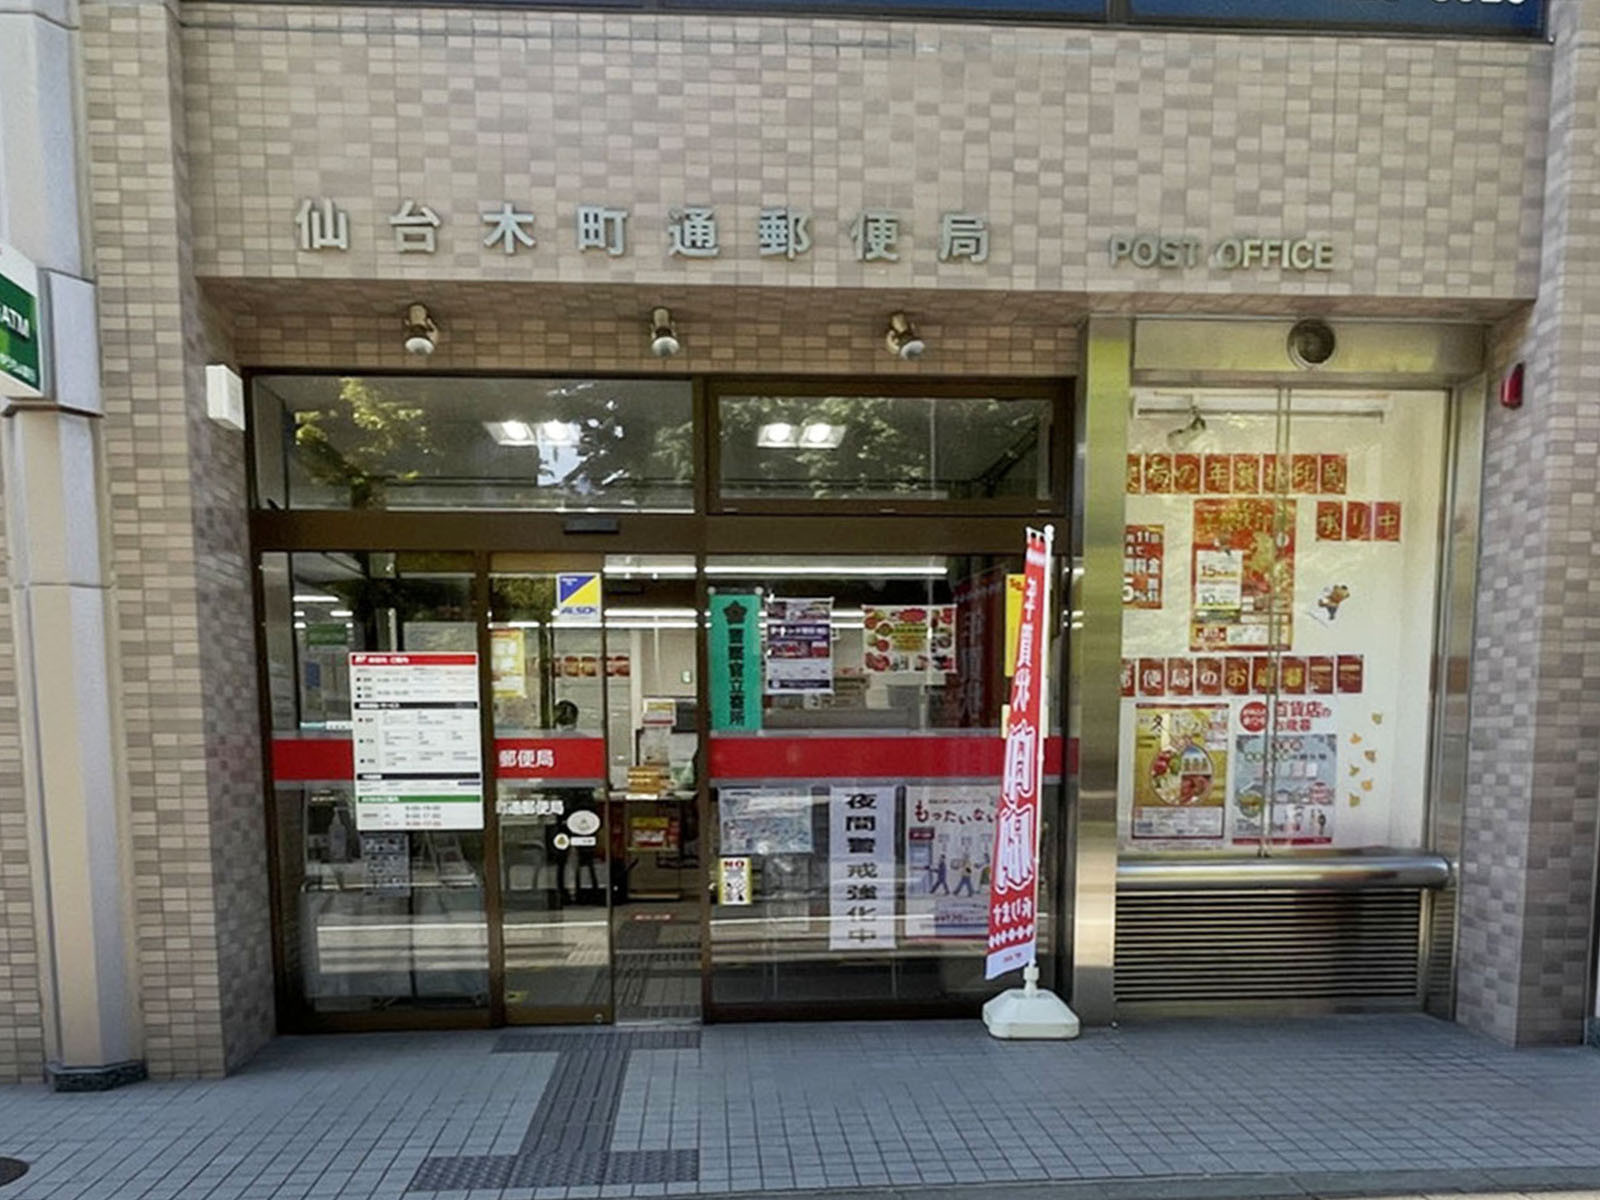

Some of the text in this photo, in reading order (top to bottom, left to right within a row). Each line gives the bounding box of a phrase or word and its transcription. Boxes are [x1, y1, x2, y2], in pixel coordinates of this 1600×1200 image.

[295, 199, 990, 264] 仙台木町通郵便局
[1109, 235, 1334, 271] POST OFFICE
[499, 749, 554, 768] 郵便局
[845, 793, 878, 942] 夜間警戒強化中
